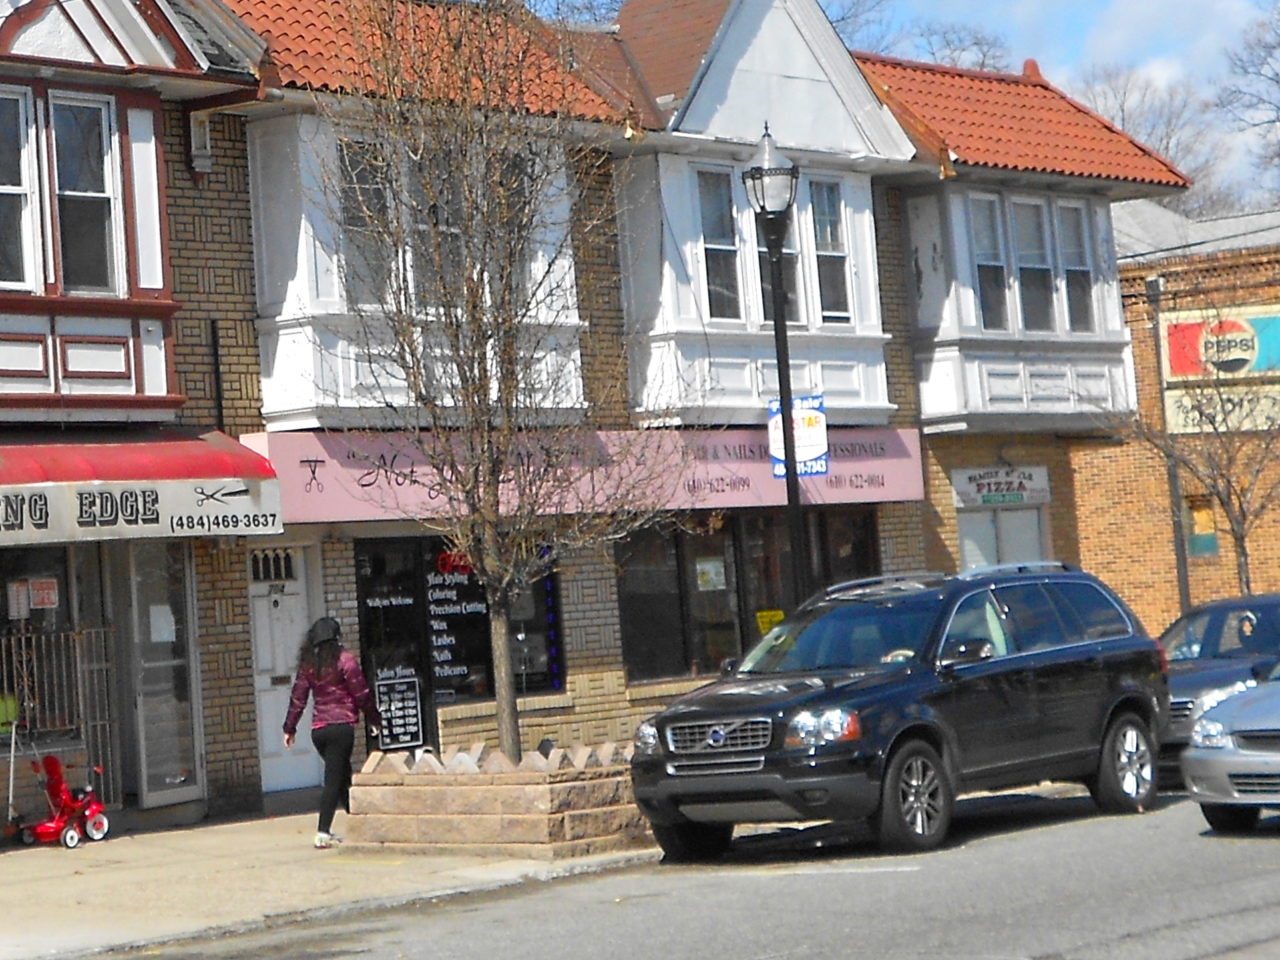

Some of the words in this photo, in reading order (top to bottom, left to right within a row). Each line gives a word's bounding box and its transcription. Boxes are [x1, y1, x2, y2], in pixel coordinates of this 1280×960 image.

[1204, 337, 1256, 353] PEPSI
[723, 443, 755, 459] NAILS
[976, 481, 1027, 493] PIZZA
[76, 489, 161, 528] EDGE
[169, 512, 277, 535] (484)469-3637
[428, 589, 457, 601] Coloring
[429, 603, 461, 615] Precision
[461, 602, 487, 614] Cutting
